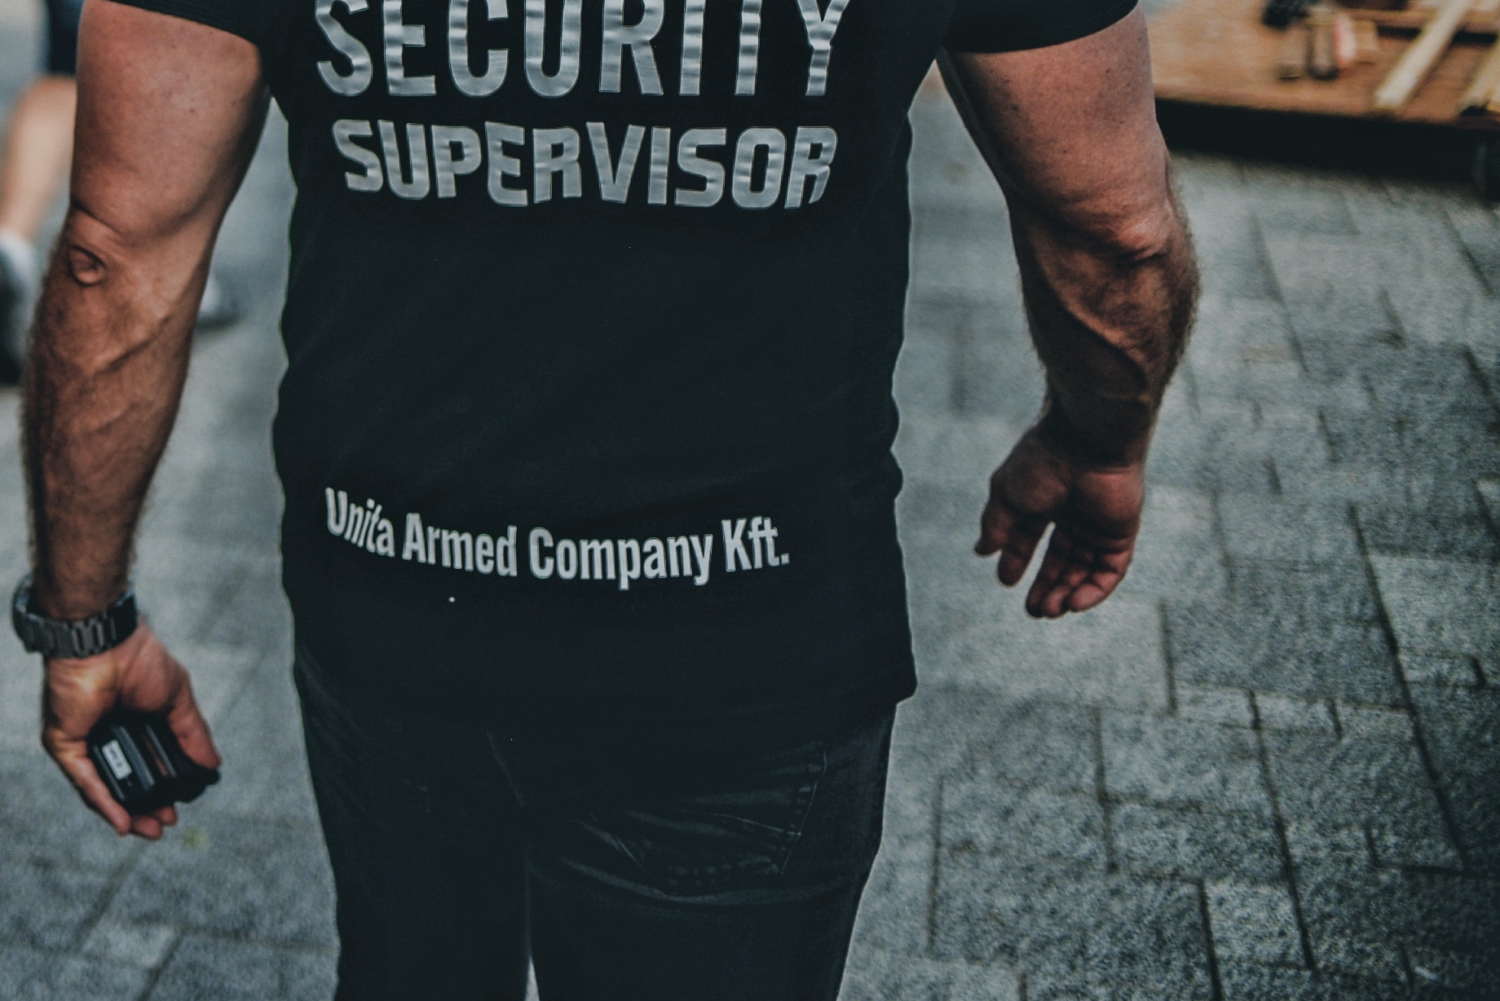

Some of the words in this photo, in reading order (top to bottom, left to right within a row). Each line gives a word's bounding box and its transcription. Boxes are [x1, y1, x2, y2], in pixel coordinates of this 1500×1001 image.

[332, 119, 838, 209] SUPERVISOR
[325, 487, 395, 557] Unita
[402, 513, 518, 577] Armed
[528, 527, 714, 591] Company
[721, 516, 790, 572] Kft.
